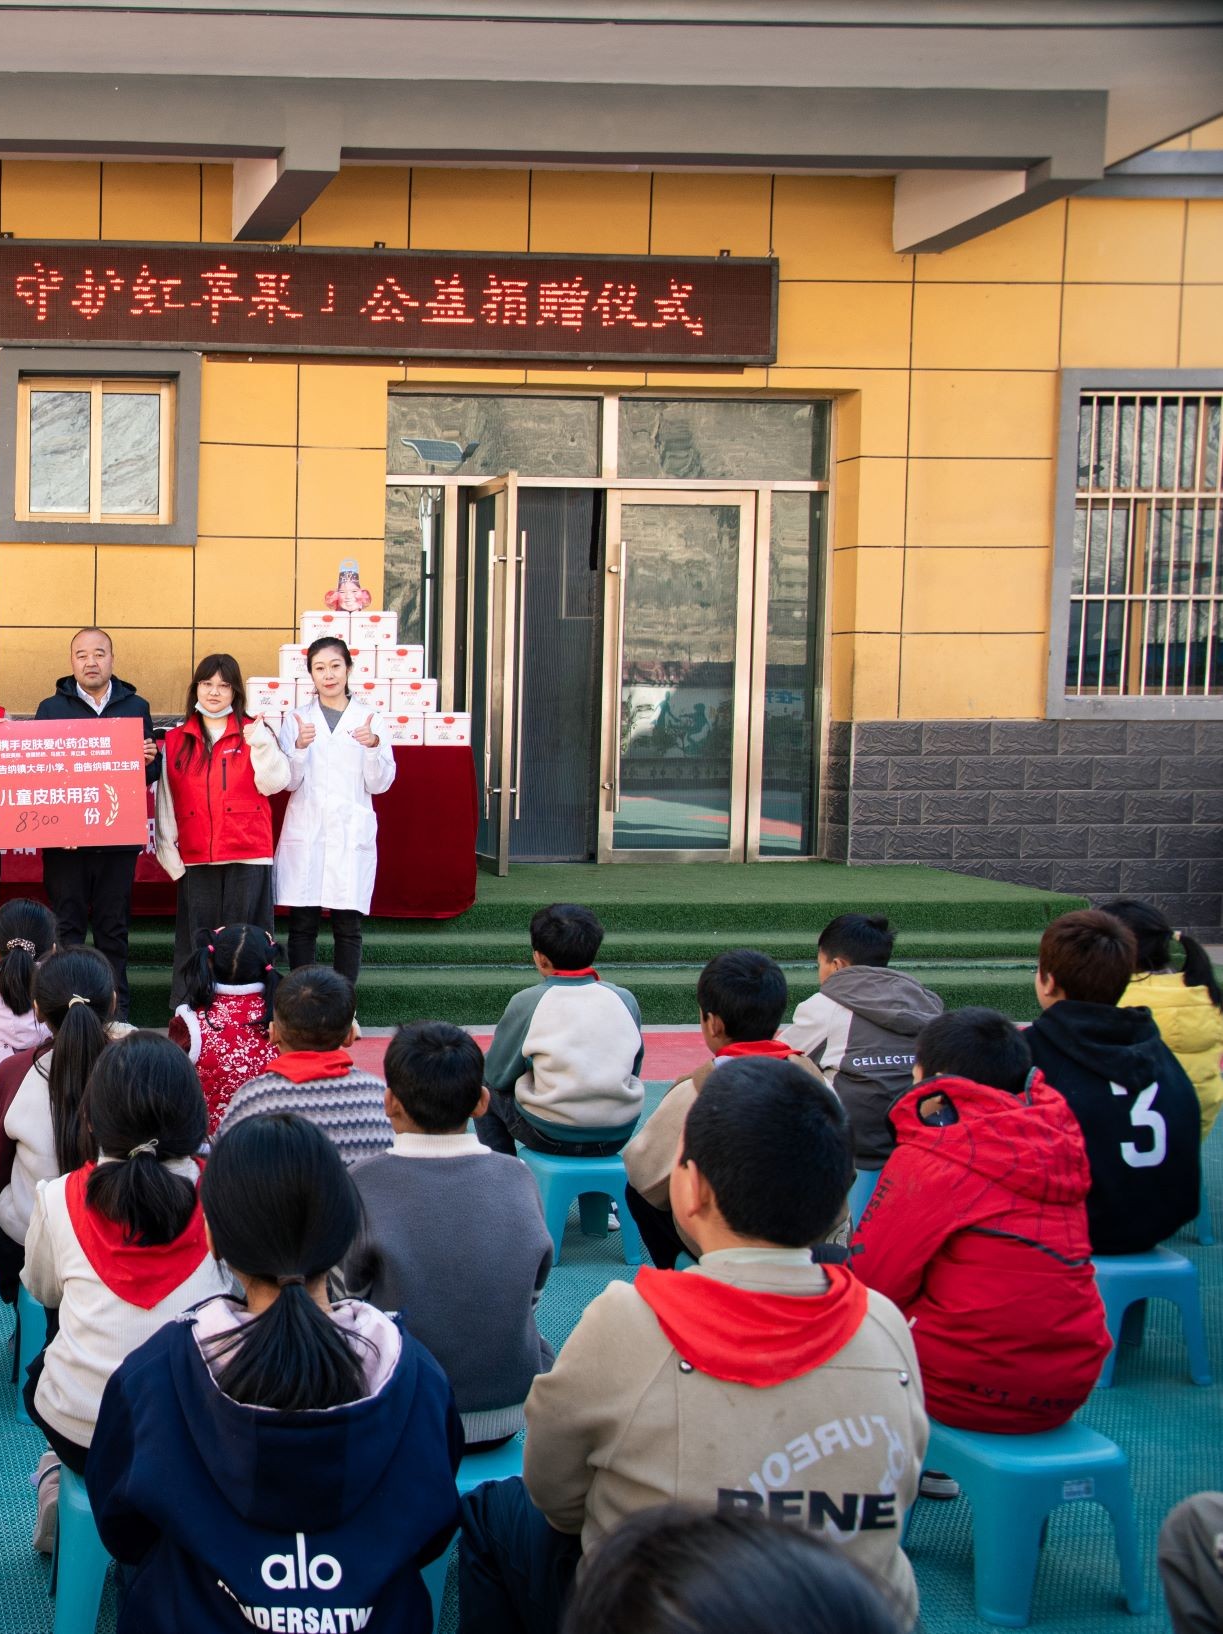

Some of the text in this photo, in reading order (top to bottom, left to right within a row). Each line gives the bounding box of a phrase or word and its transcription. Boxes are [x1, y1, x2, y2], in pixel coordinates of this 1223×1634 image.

[15, 810, 59, 832] 8300
[84, 807, 101, 825] 份
[1110, 1081, 1167, 1168] 3
[260, 1532, 343, 1590] alo
